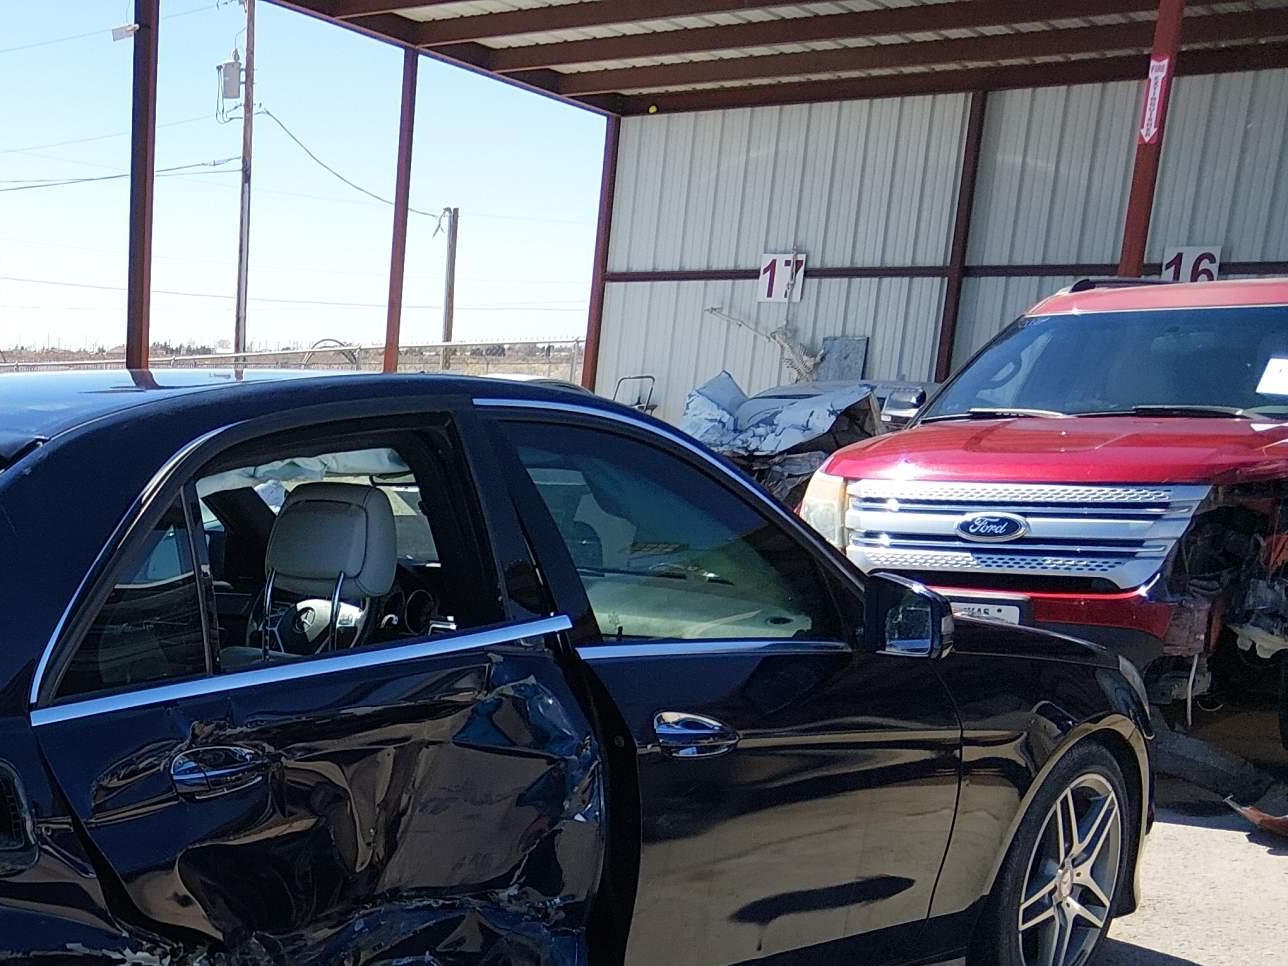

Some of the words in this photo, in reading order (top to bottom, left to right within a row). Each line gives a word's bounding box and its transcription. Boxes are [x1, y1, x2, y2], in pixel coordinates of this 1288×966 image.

[762, 258, 804, 299] 17
[1164, 251, 1217, 283] 16
[968, 517, 1009, 535] Ford
